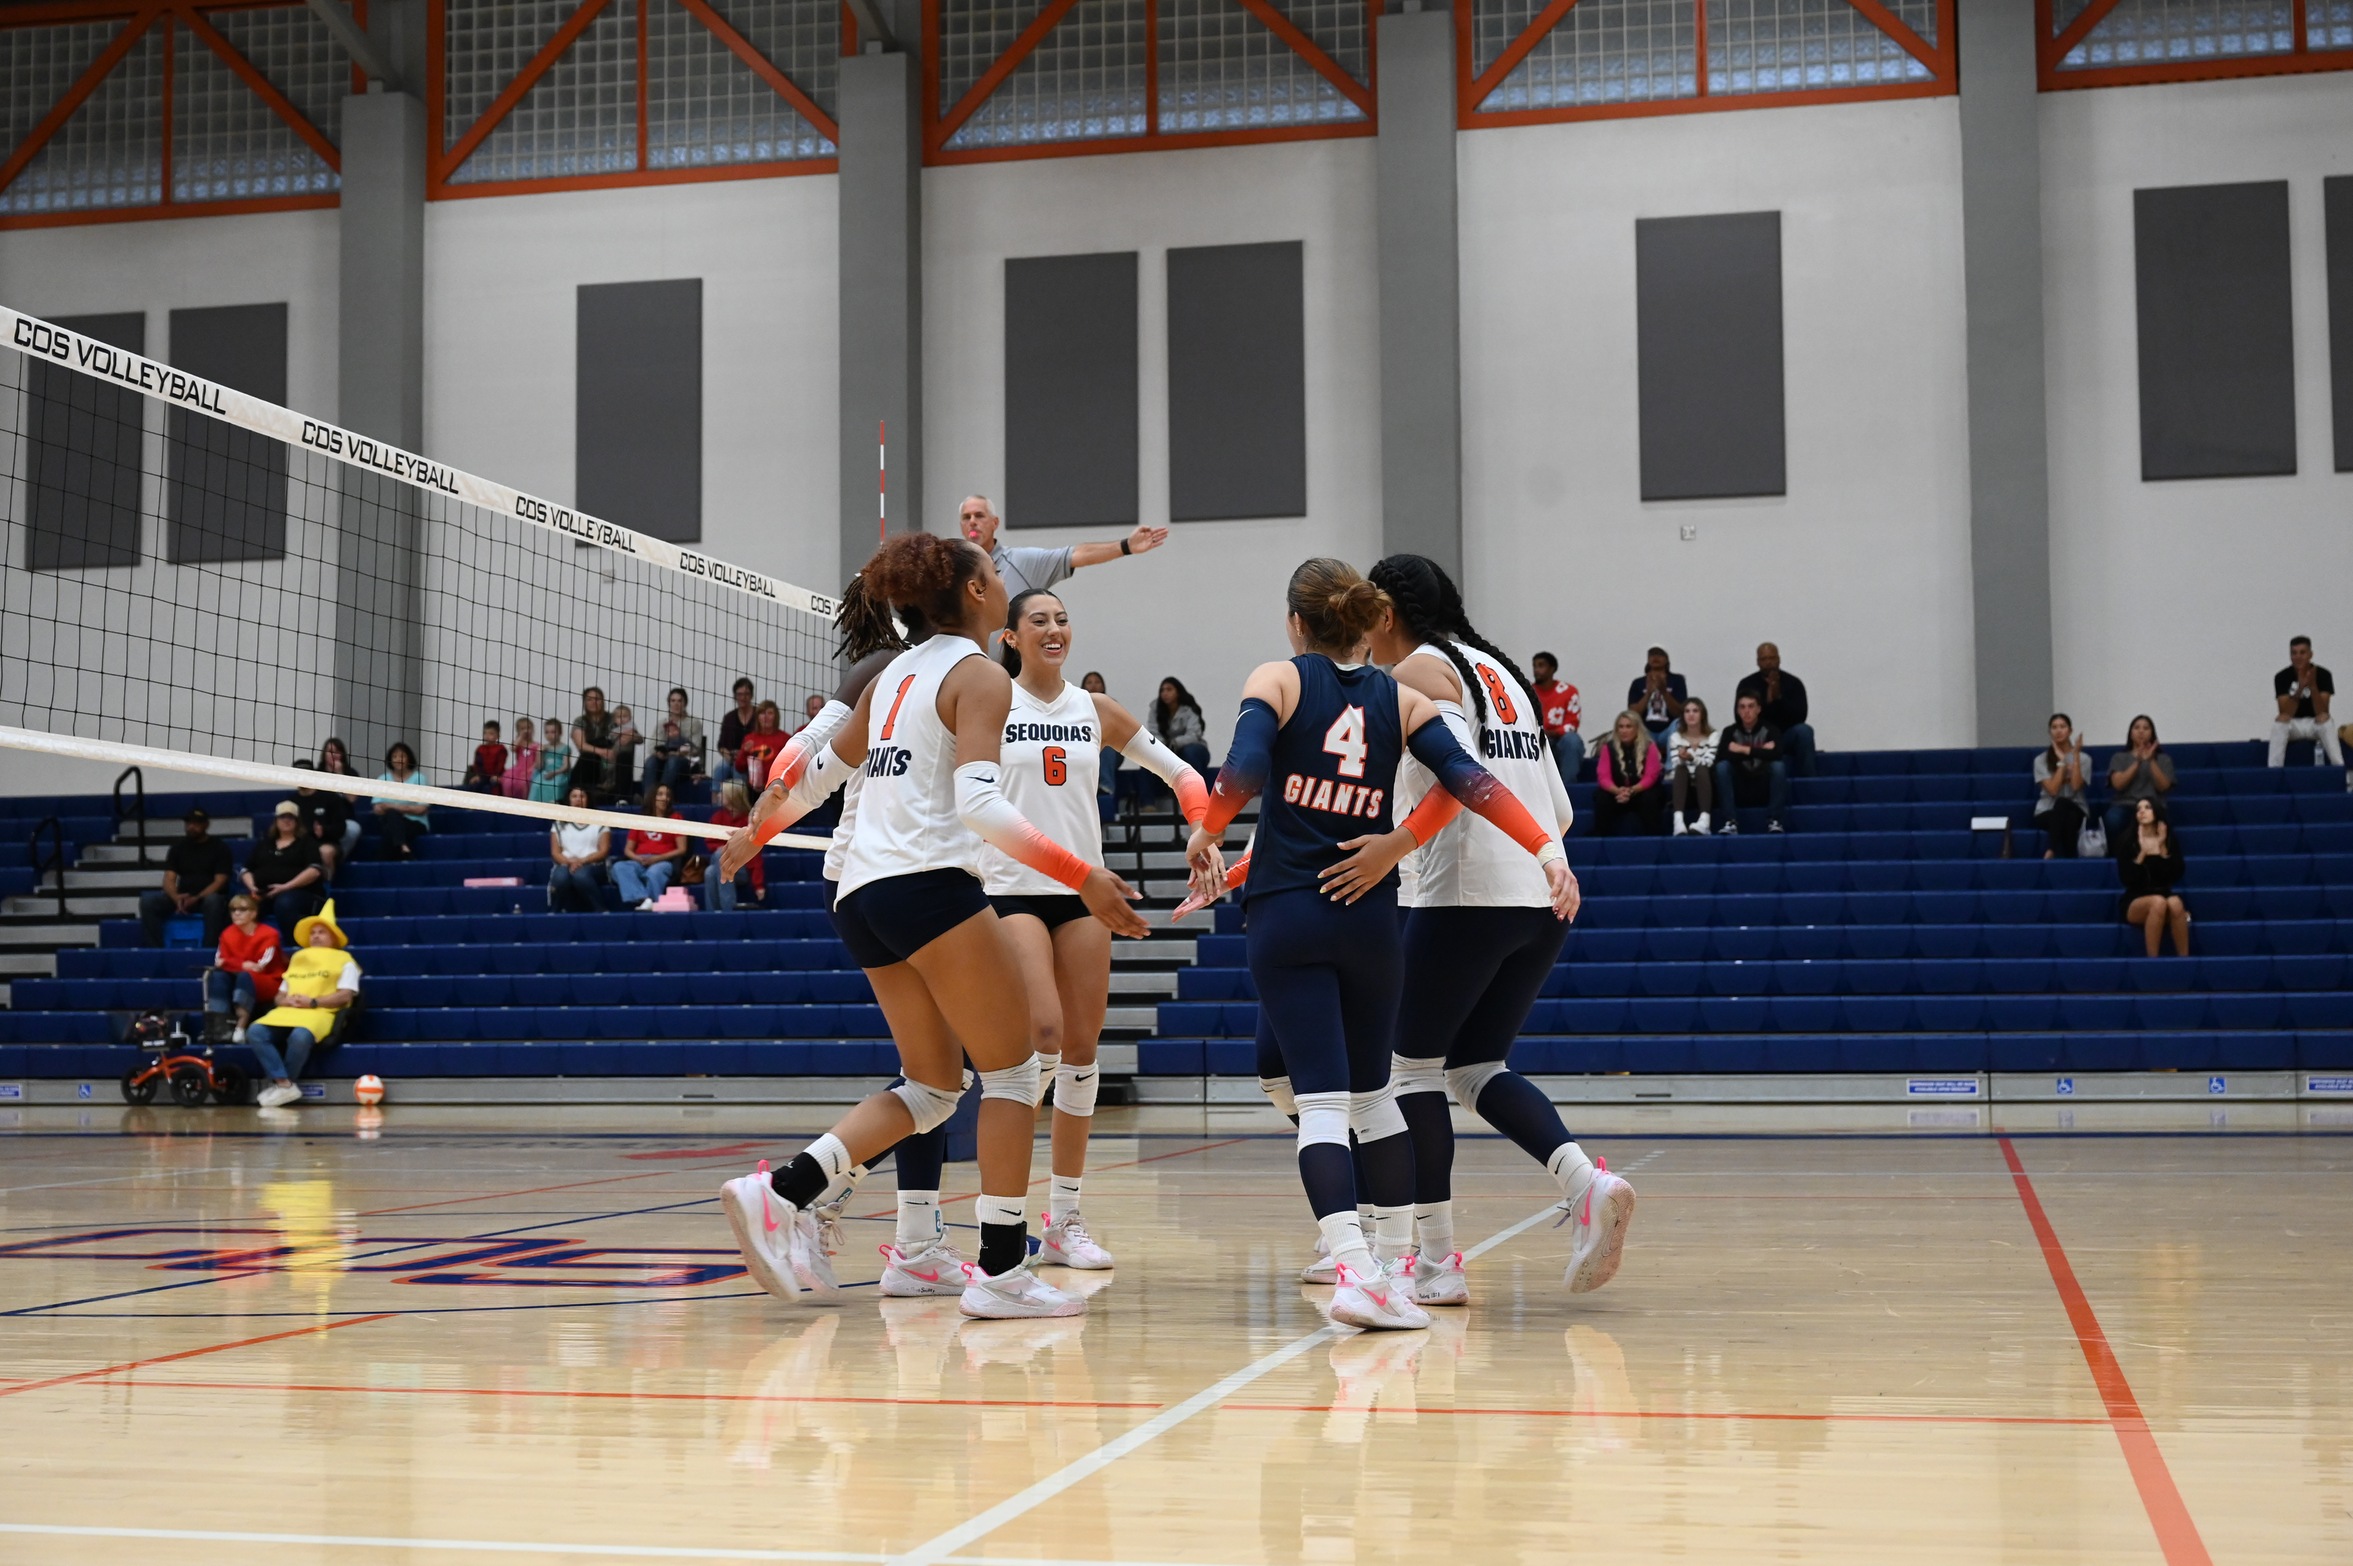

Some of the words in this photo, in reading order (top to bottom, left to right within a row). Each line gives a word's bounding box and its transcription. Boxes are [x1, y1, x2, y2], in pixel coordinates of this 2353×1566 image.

[14, 317, 70, 360] COS
[77, 339, 227, 415] VOLLEYBALL
[302, 421, 343, 454] COS
[347, 435, 459, 495] VOLLEYBALL
[515, 496, 547, 523] COS
[550, 506, 636, 553] VOLLEYBALL
[680, 552, 705, 576] COS
[707, 560, 776, 598] VOLLEYBALL
[811, 594, 831, 615] COS
[880, 674, 916, 740] 1
[1475, 662, 1518, 725] 8
[1005, 723, 1092, 743] SEQUOIAS
[1322, 703, 1368, 779] 4
[1485, 729, 1540, 762] GIANTS
[866, 746, 912, 777] IANTS
[1042, 746, 1067, 786] 6
[1283, 773, 1384, 819] GIANTS
